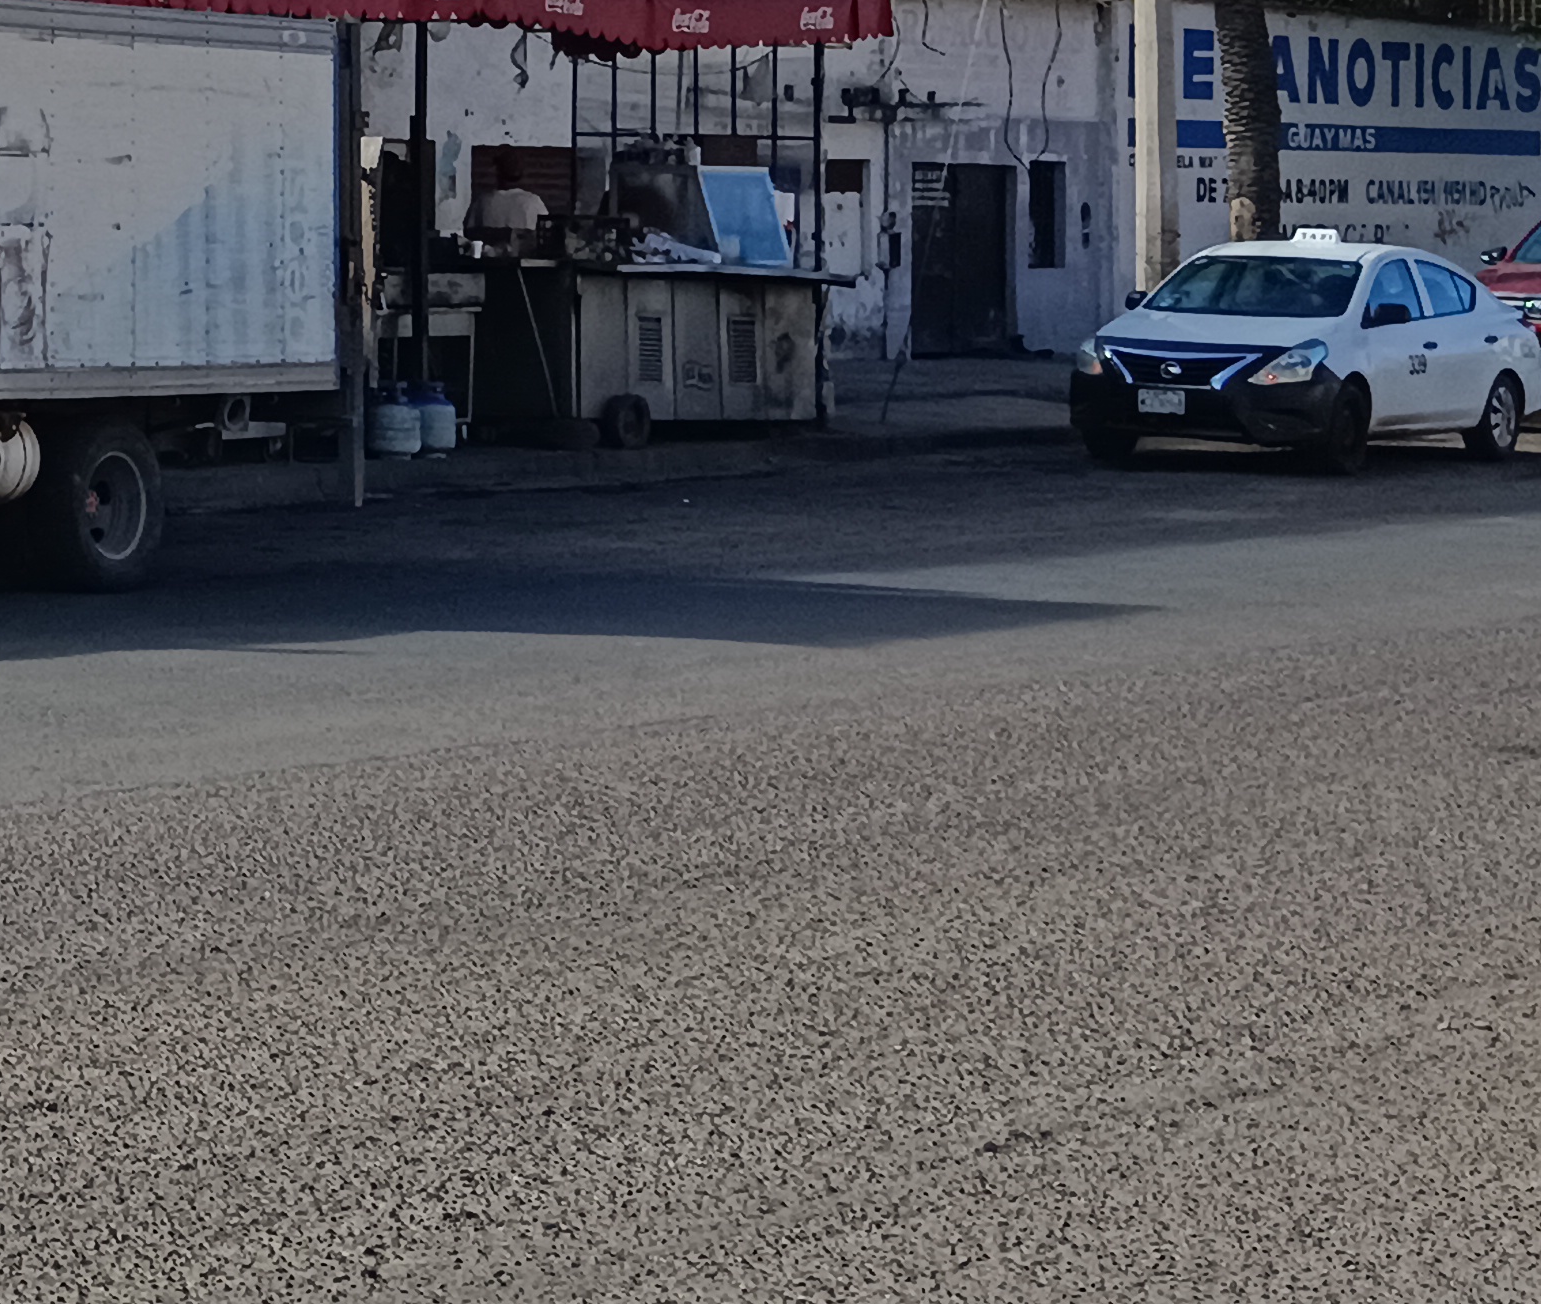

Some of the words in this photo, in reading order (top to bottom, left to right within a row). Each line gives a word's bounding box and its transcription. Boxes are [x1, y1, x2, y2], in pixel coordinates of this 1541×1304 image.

[1287, 127, 1377, 151] GUAYMAS
[1196, 177, 1217, 203] DE
[1366, 179, 1415, 205] CANAL
